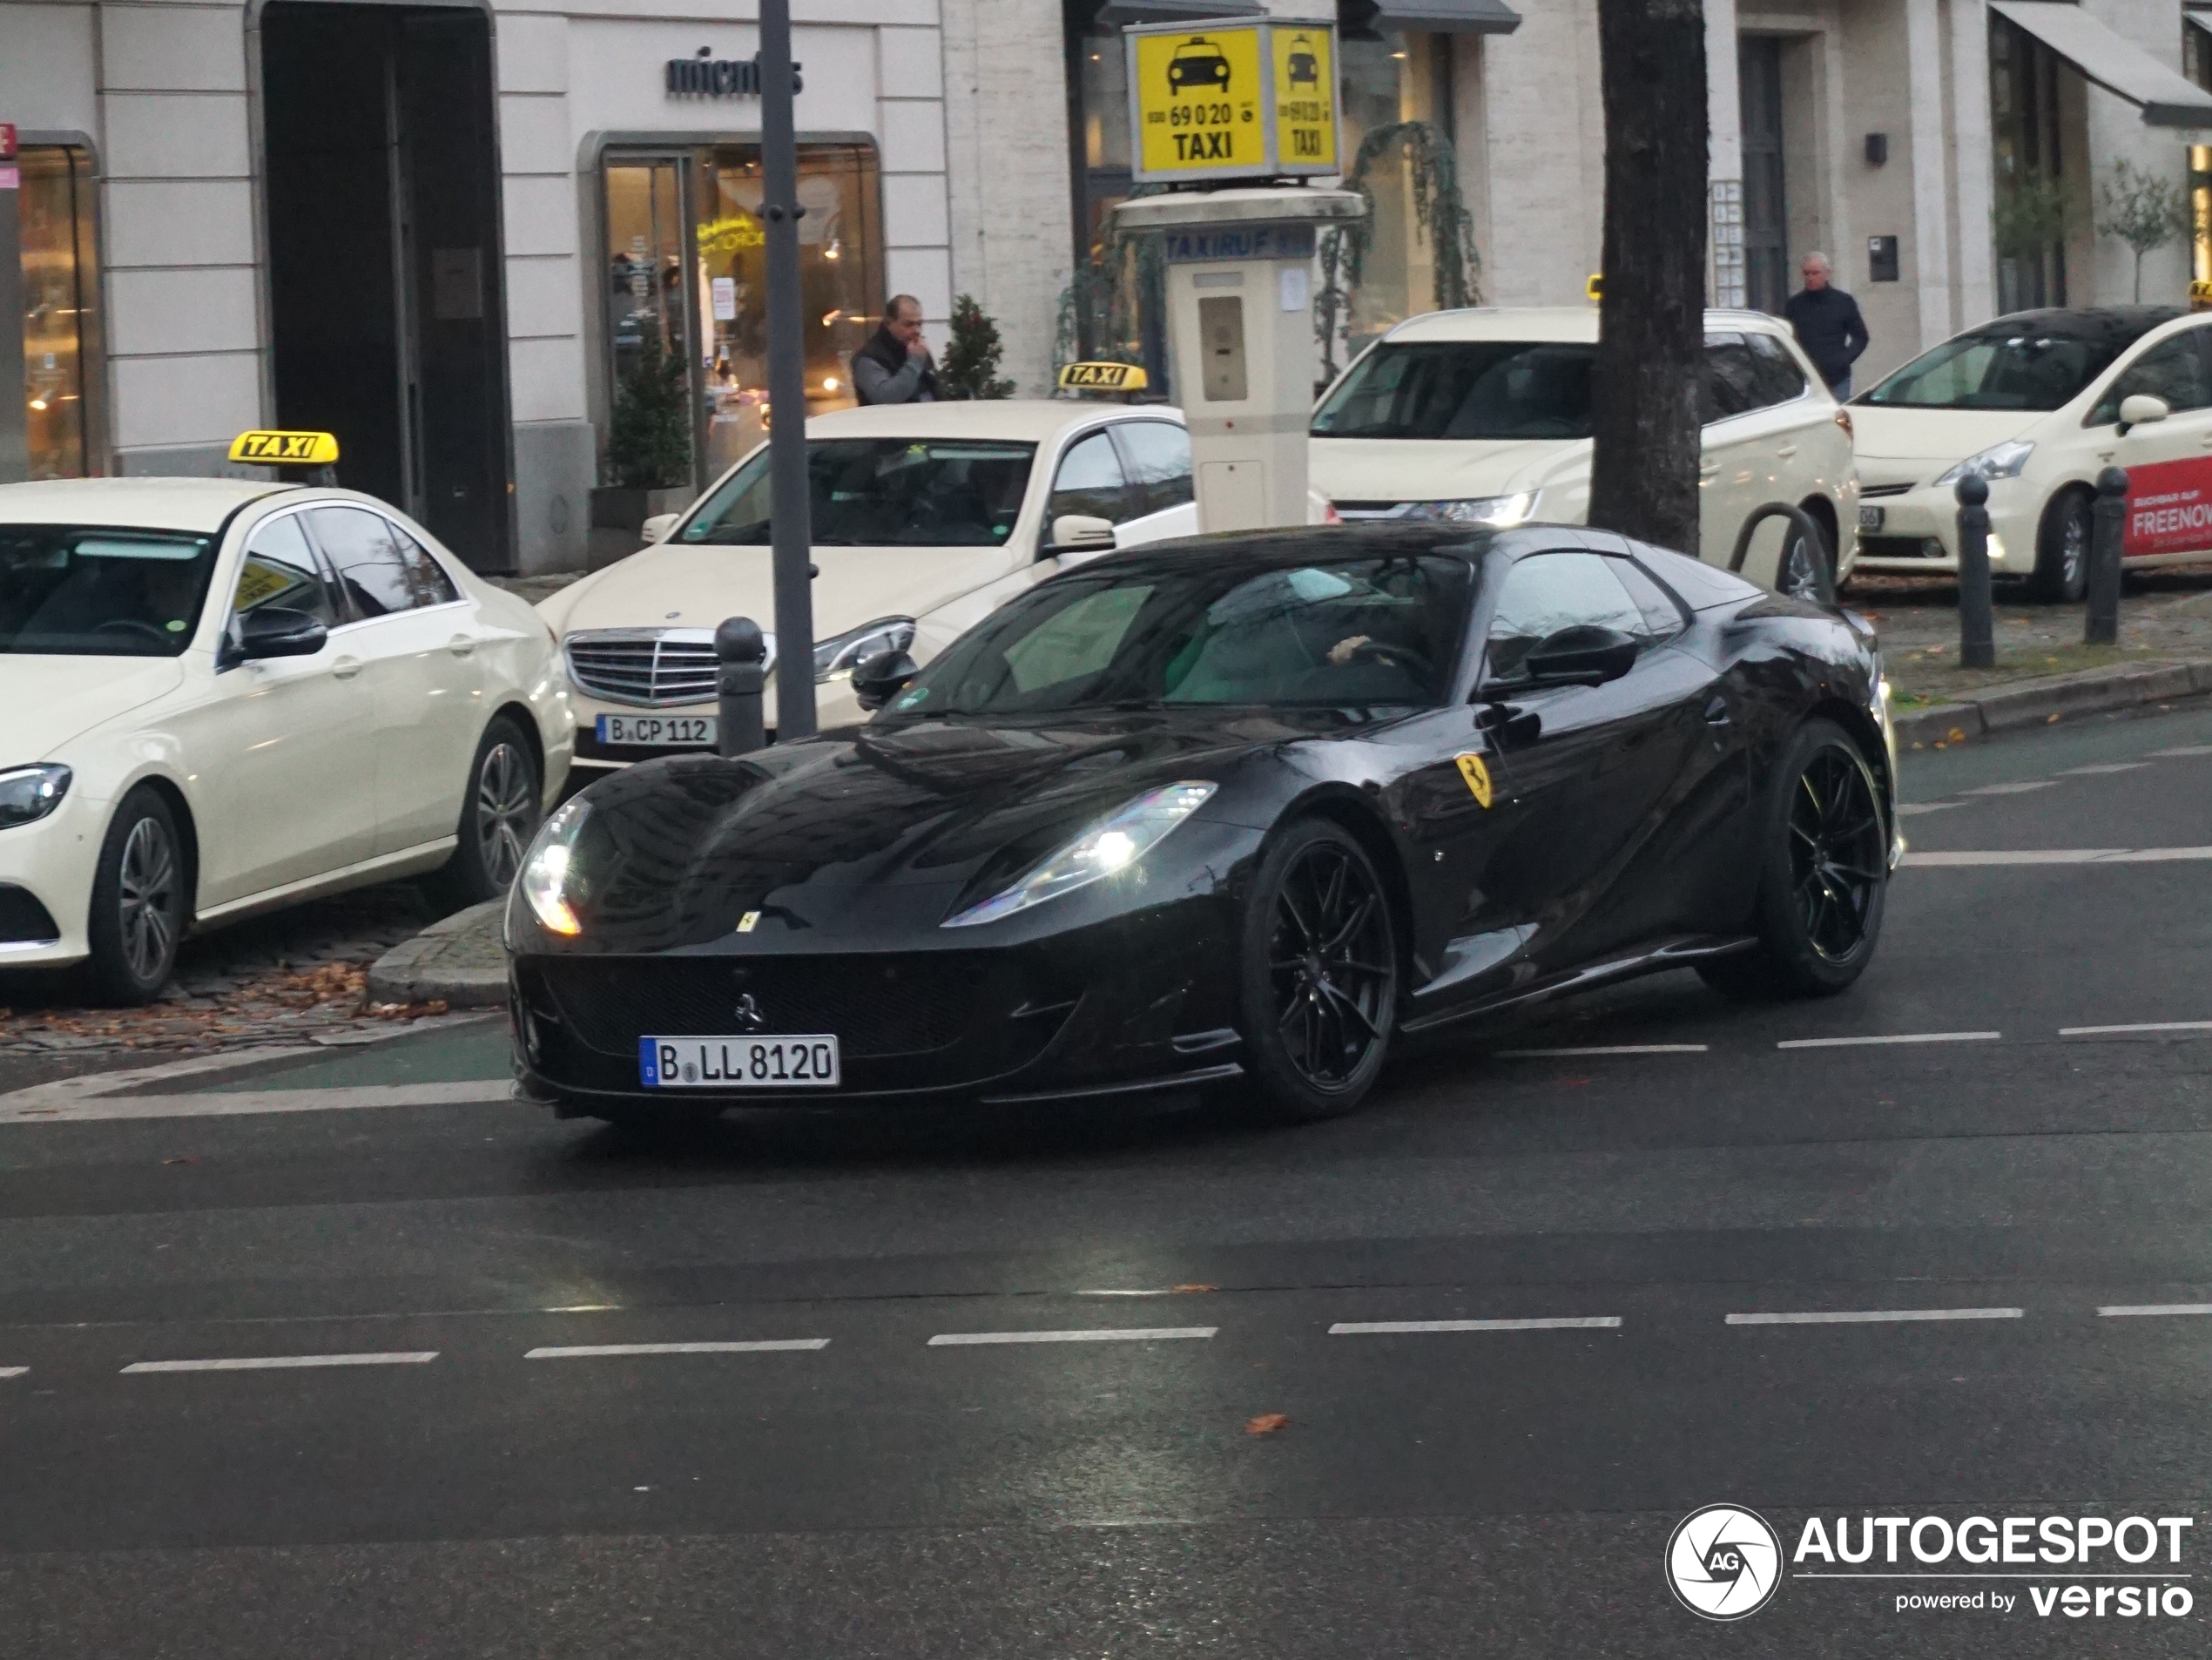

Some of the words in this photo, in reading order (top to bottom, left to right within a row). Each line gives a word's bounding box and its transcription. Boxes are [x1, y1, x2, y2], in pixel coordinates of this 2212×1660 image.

[1172, 130, 1232, 160] TAXI
[1292, 128, 1321, 156] TAXI
[1071, 366, 1123, 384] TAXI
[246, 435, 316, 456] TAXI
[611, 719, 624, 740] B
[637, 719, 662, 741] CP
[667, 719, 707, 742] 112
[660, 1045, 679, 1080] B
[700, 1045, 742, 1080] LL
[750, 1043, 832, 1080] 8120
